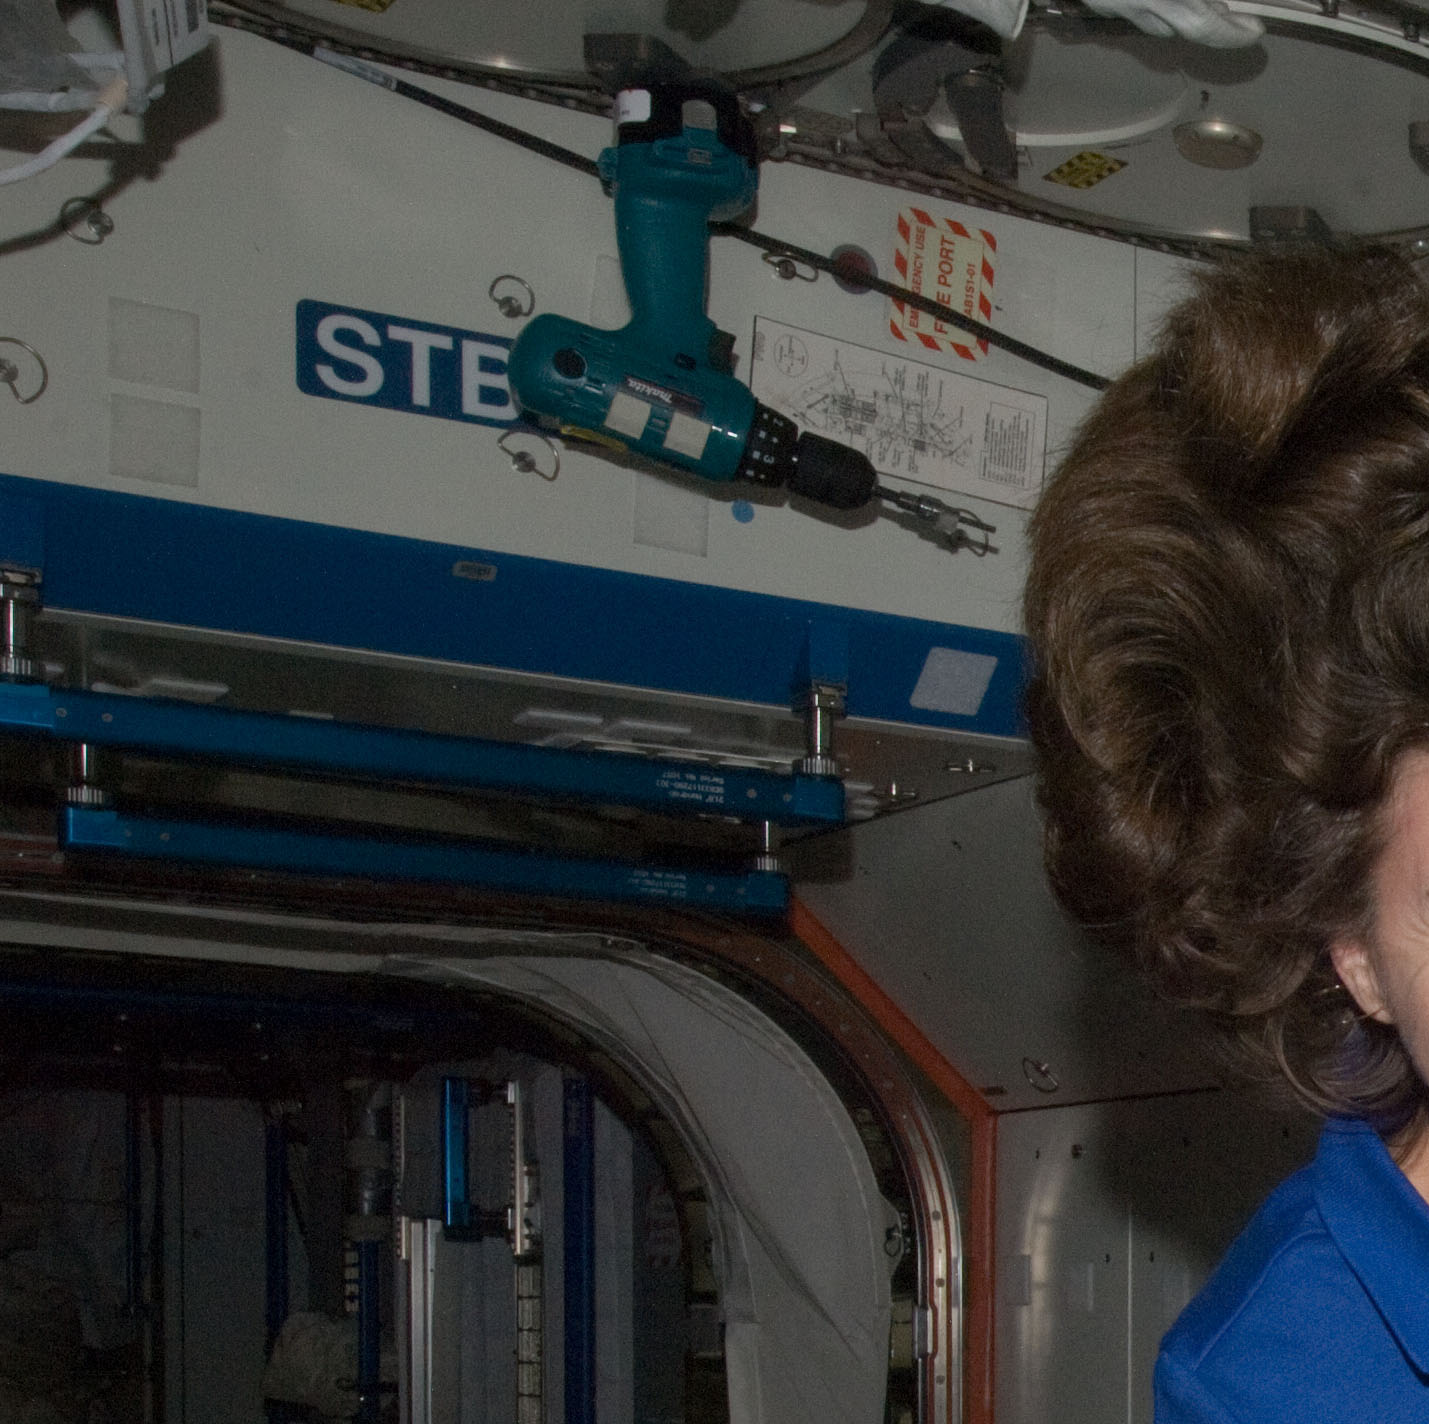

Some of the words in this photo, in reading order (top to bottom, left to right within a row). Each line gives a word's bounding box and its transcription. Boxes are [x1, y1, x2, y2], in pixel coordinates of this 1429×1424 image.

[915, 225, 926, 251] USE
[938, 234, 956, 288] PORT
[909, 252, 925, 329] EMGENCY
